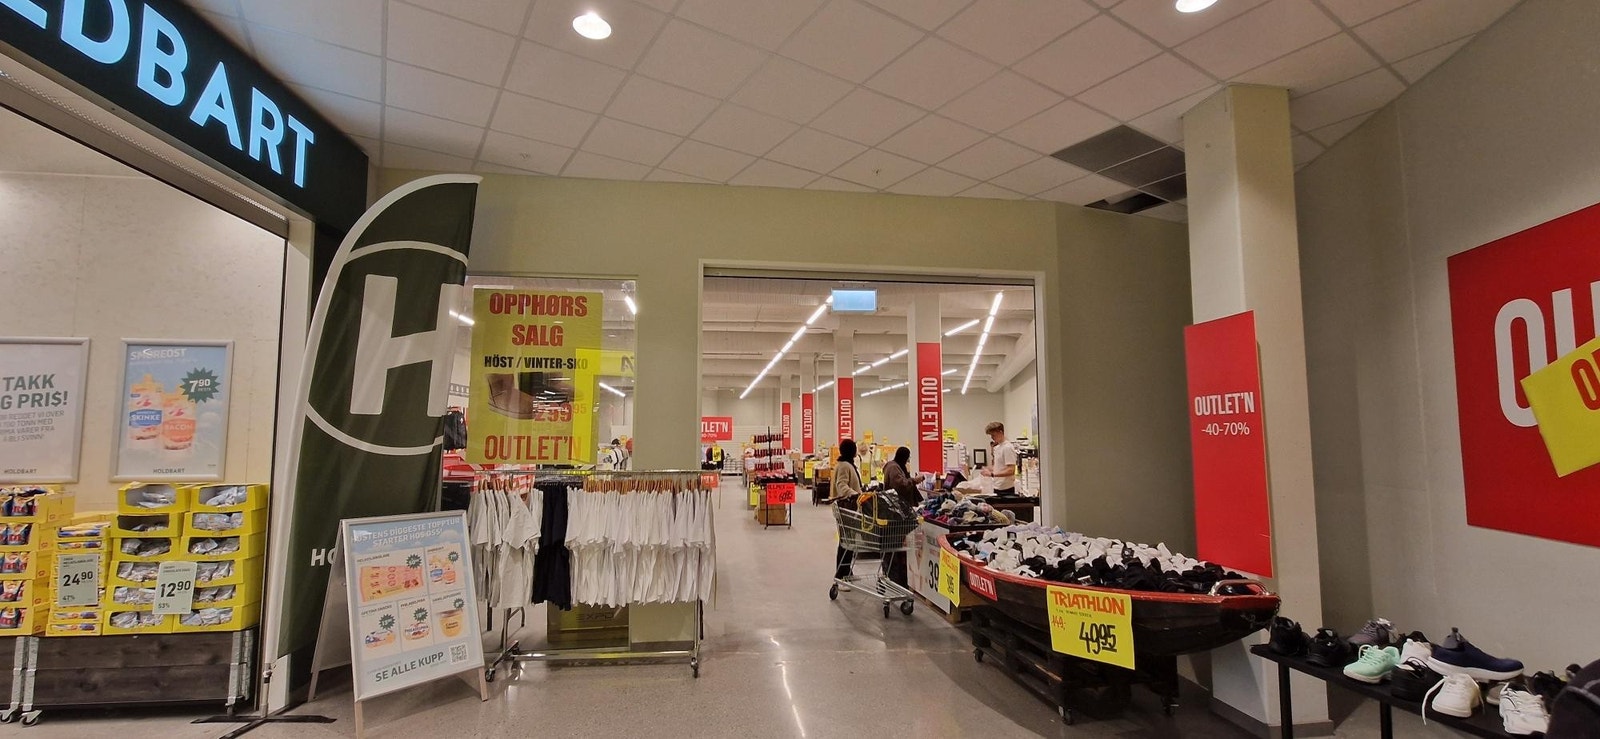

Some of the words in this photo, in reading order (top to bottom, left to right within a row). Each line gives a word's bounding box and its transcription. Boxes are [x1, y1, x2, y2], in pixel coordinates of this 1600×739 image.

[0, 0, 315, 189] DBART
[489, 292, 588, 317] OPPHØRS
[349, 274, 464, 418] H
[511, 324, 564, 347] SALG
[484, 353, 514, 368] HÖST
[524, 356, 589, 370] VINTER-SKO
[2, 373, 56, 392] TAKK
[1570, 349, 1600, 412] O
[920, 377, 940, 442] OUTLET'N
[1194, 391, 1255, 417] OUTLET'N
[131, 413, 160, 422] SKINKE
[840, 399, 852, 440] OUTLET'N
[1201, 422, 1250, 436] -40-70%
[484, 435, 582, 461] OUTLET'N
[62, 570, 94, 587] 2490
[160, 580, 192, 598] 1290
[969, 571, 994, 595] OUTLET'N
[1050, 590, 1126, 616] TRIATHLON
[1079, 621, 1118, 655] 4995
[375, 669, 389, 683] SE
[391, 660, 417, 677] ALLE
[418, 651, 445, 668] KUPP
